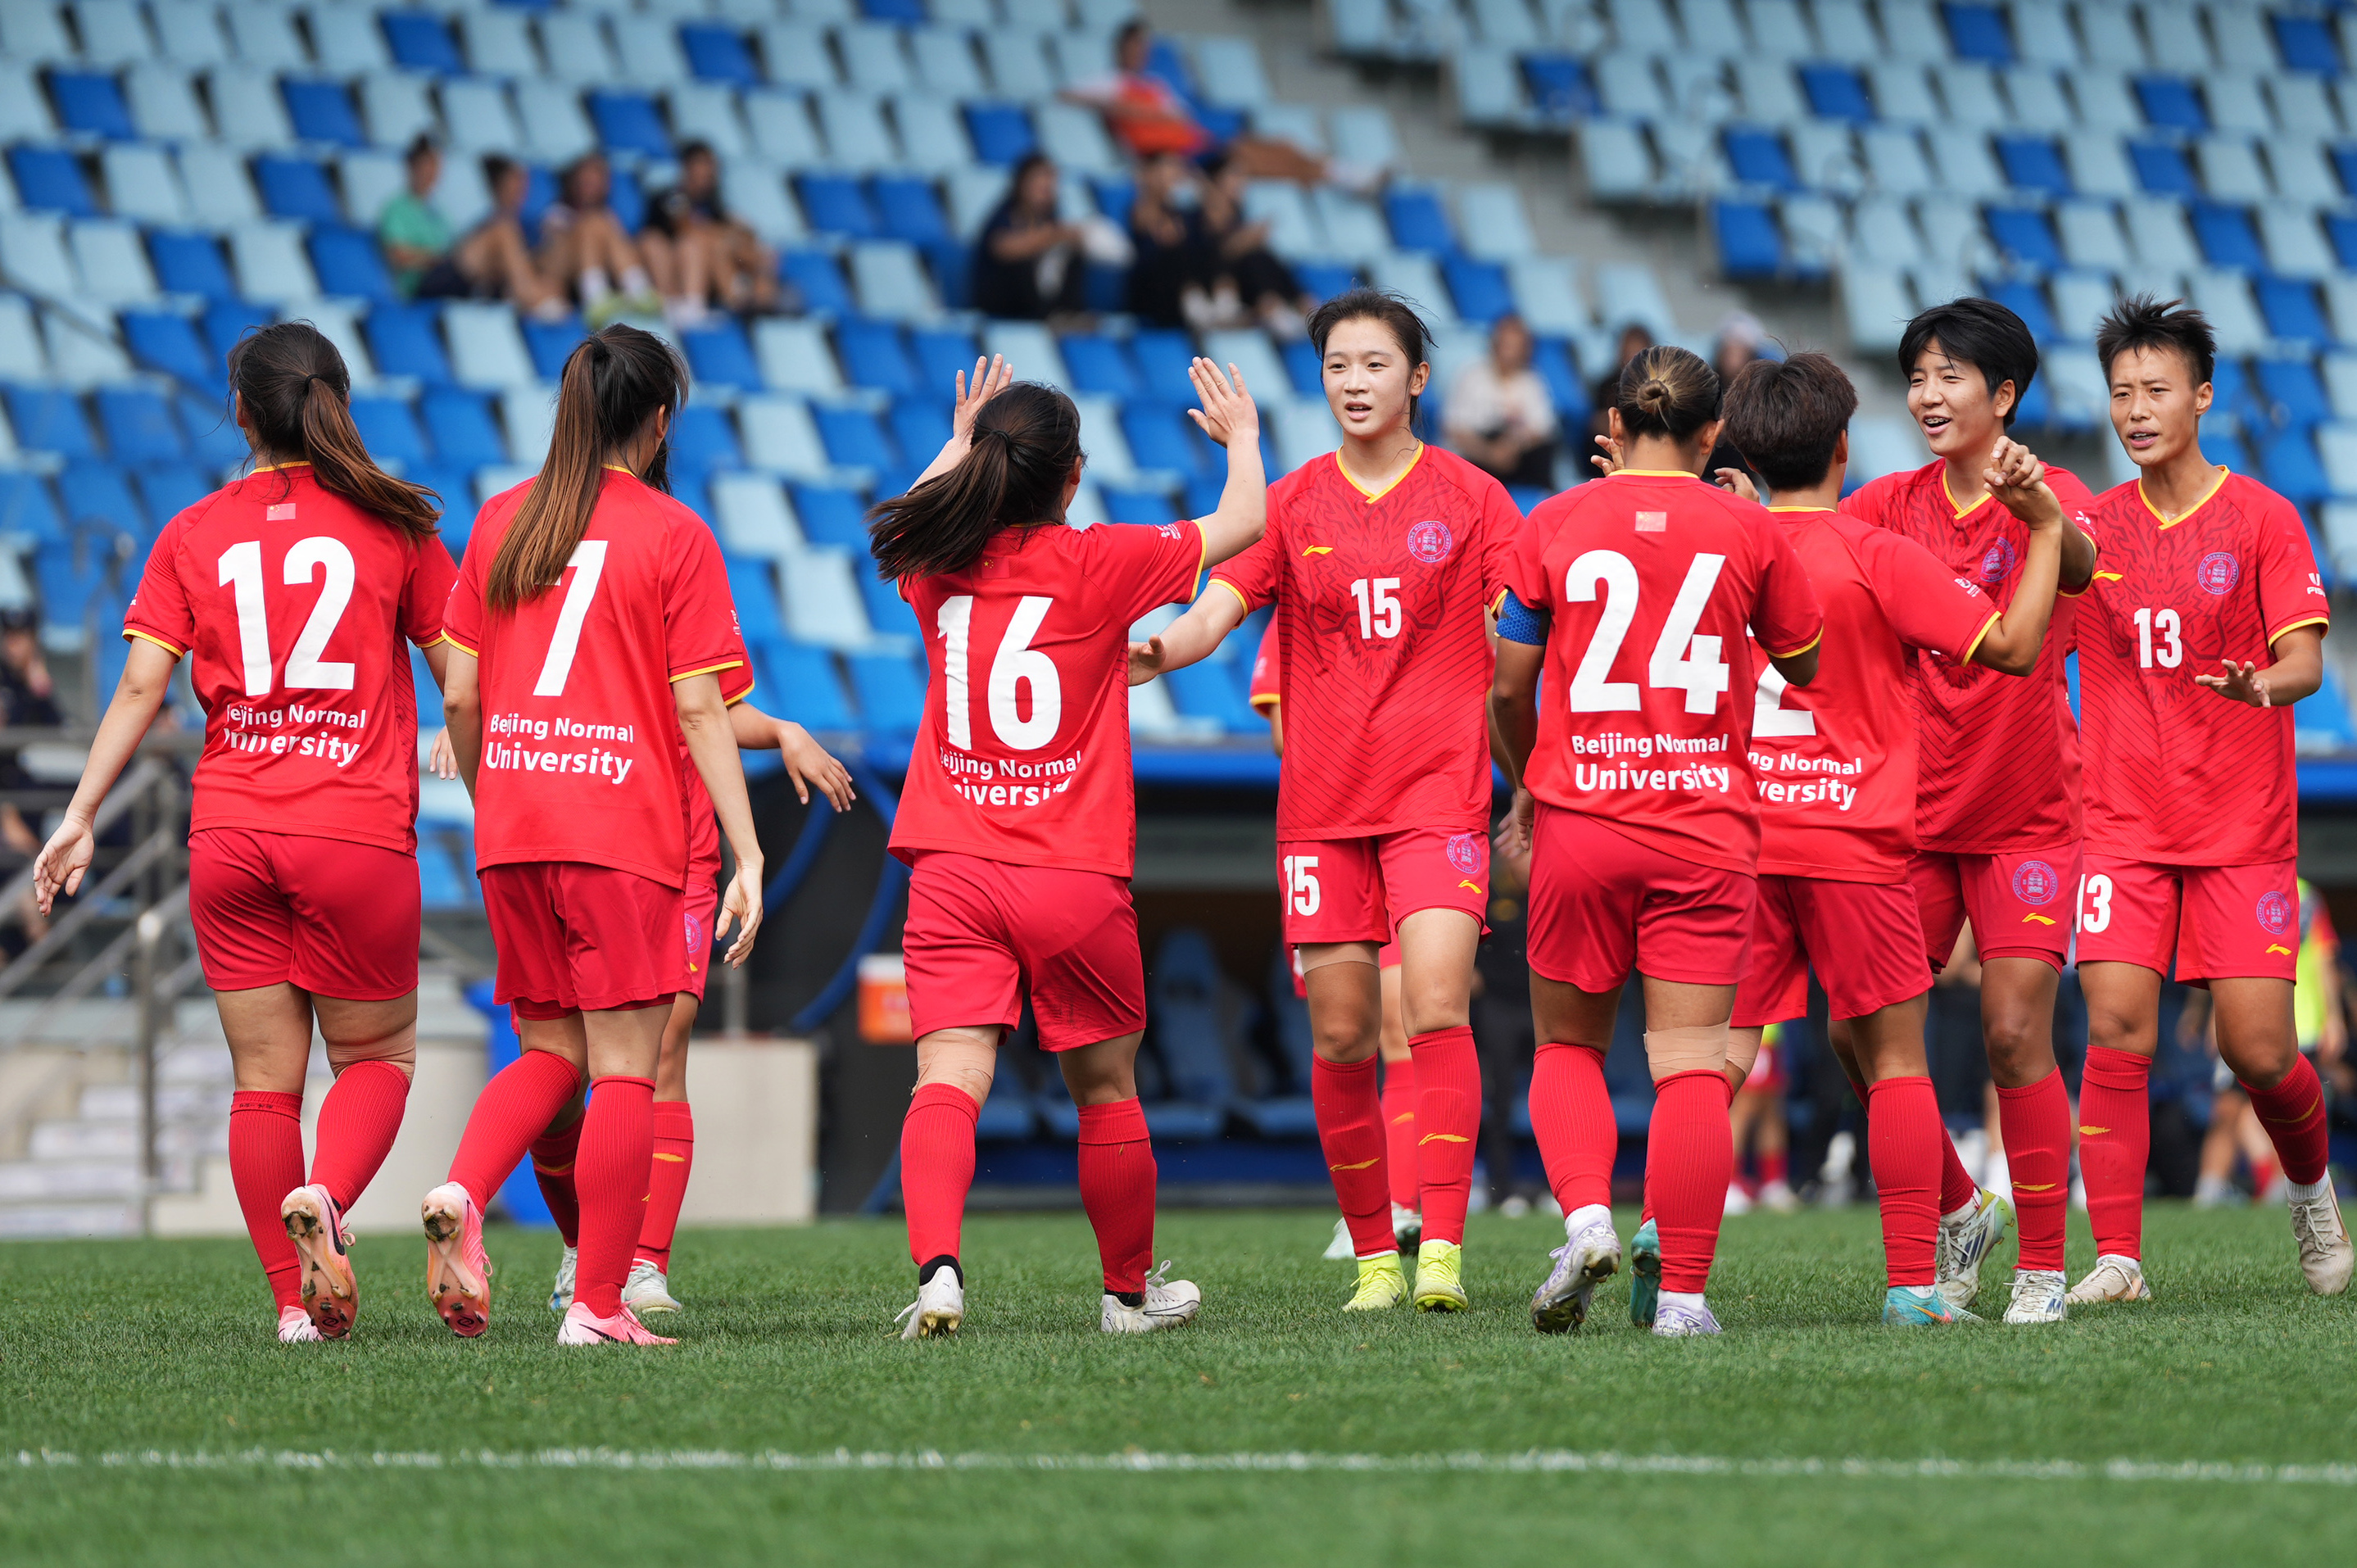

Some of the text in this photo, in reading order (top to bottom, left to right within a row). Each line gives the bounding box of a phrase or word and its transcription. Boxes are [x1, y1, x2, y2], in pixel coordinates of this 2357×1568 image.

[218, 536, 355, 696] 12
[533, 540, 608, 696] 7
[1350, 578, 1402, 639] 15
[1566, 550, 1730, 715] 24
[2133, 608, 2182, 668] 13
[937, 596, 1062, 750] 16
[288, 704, 366, 728] Normal
[554, 718, 633, 743] Normal
[486, 741, 632, 785] University
[999, 750, 1081, 777] Normal
[1571, 732, 1729, 759] Beijing Normal
[1779, 753, 1862, 774] Normal
[1575, 761, 1729, 793] University
[1756, 778, 1857, 810] versity
[1283, 855, 1320, 916] 15
